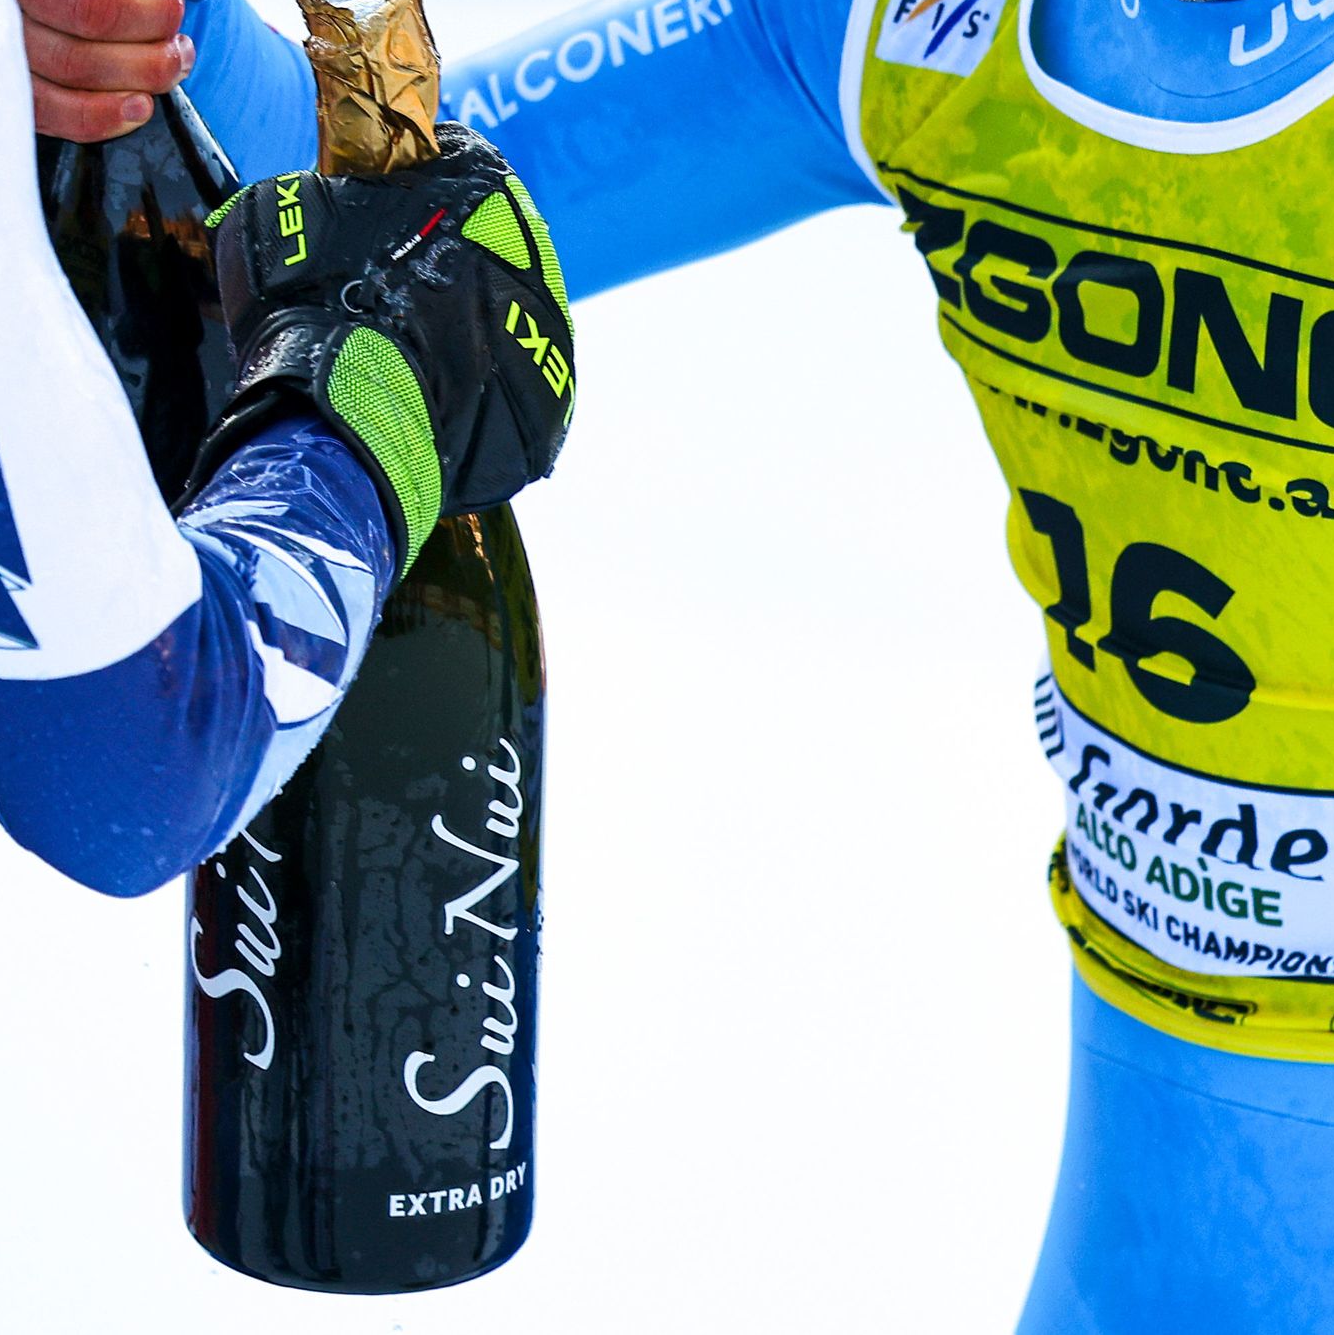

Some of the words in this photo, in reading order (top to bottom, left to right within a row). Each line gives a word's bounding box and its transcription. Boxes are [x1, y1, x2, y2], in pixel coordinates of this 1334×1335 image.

[275, 172, 308, 266] LEKI
[1018, 485, 1257, 724] 16
[431, 736, 525, 940] Nui
[1123, 888, 1159, 931] SKI
[403, 954, 516, 1151] Sui
[388, 1184, 484, 1219] EXTRA
[489, 1160, 530, 1203] DRY
